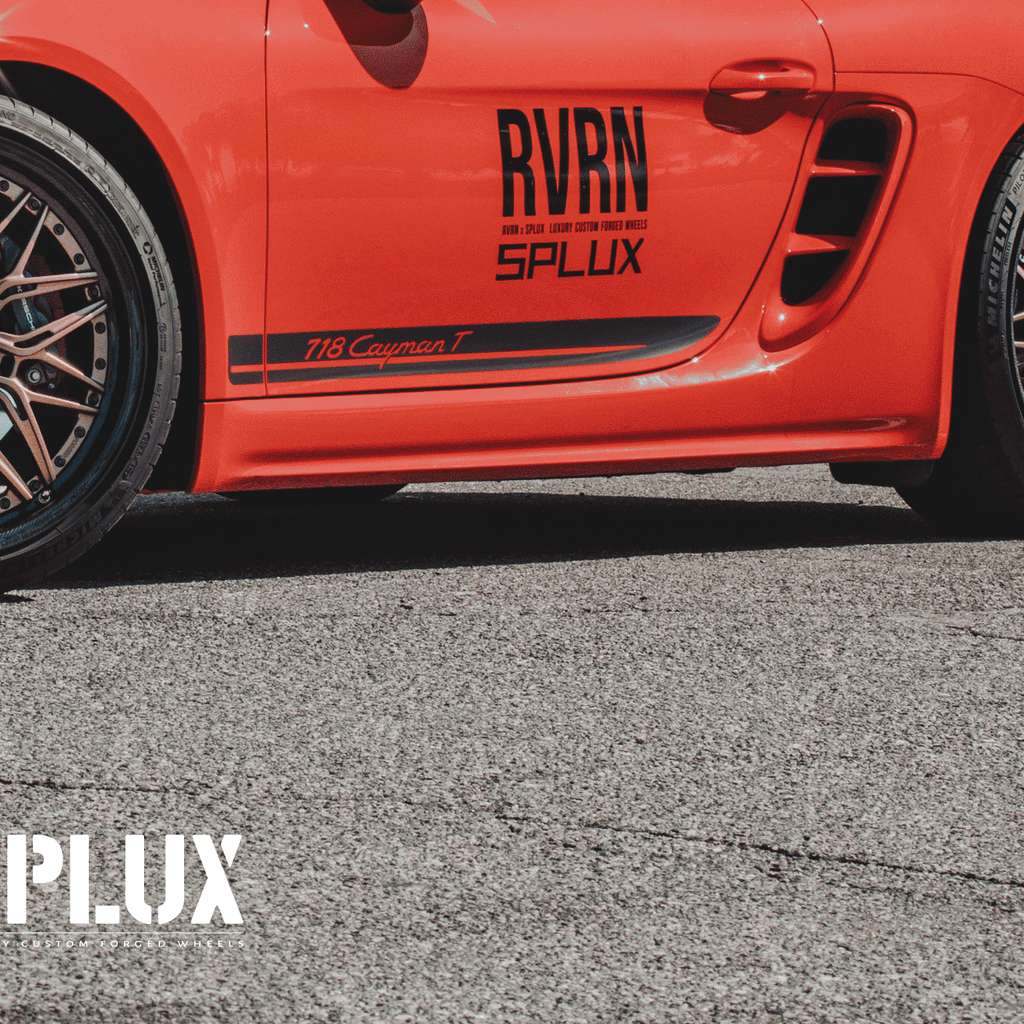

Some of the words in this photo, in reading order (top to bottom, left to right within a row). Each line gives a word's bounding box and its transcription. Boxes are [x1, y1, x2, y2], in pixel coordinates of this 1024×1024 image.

[497, 106, 648, 217] RVRN
[1012, 168, 1024, 195] PILO
[525, 223, 545, 235] SPLUX
[549, 222, 573, 234] LUXURY
[575, 221, 599, 233] CUSTOM
[601, 220, 623, 232] FORGED
[625, 219, 648, 231] WHEELS
[495, 238, 645, 281] SPLUX
[987, 206, 1014, 327] MICHELIN
[305, 336, 346, 360] 718
[348, 333, 445, 371] Cayman
[451, 330, 474, 352] T
